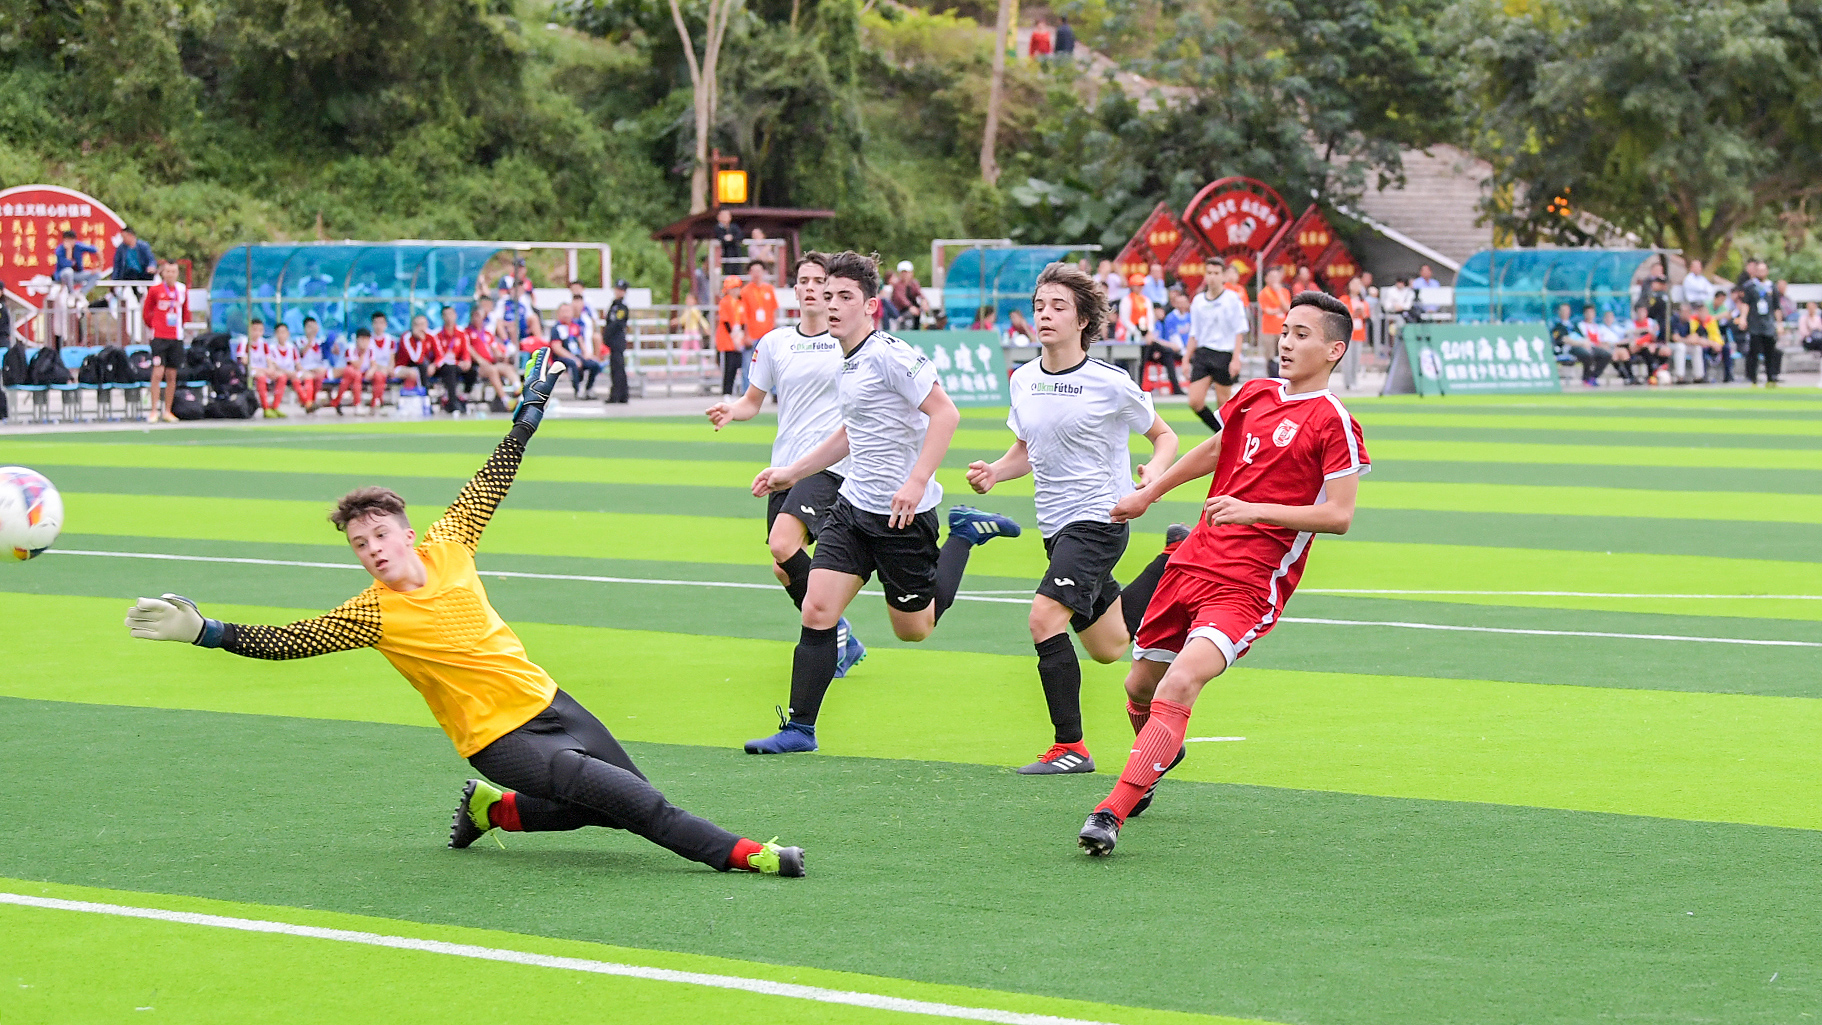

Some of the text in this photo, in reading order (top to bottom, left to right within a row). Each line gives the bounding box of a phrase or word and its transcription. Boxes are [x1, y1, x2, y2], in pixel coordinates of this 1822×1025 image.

[0, 203, 91, 217] 会主义核心价值观
[1242, 432, 1260, 464] 12
